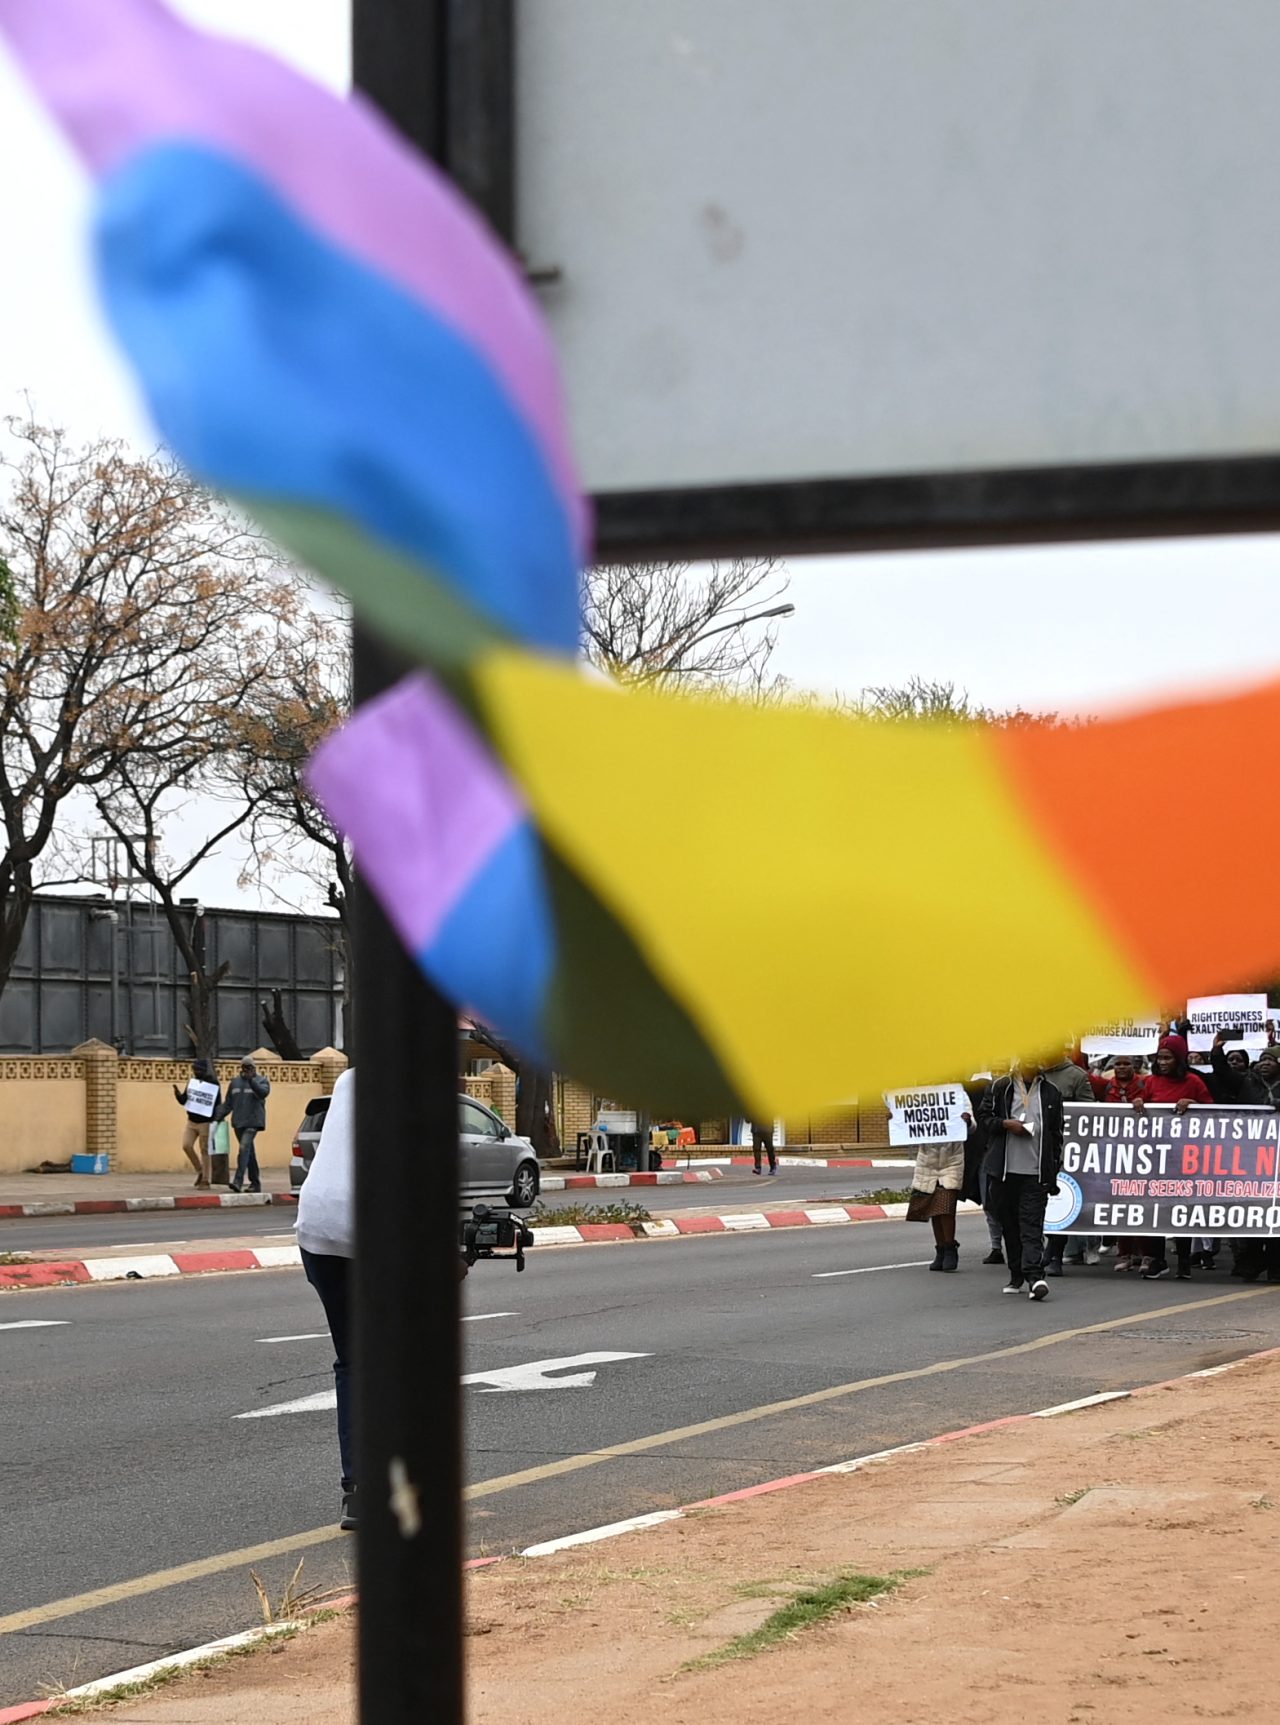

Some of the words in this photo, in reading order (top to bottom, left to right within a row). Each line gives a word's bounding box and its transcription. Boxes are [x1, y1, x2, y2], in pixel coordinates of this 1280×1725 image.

[1191, 1010, 1263, 1023] RIGHTEOUSNESS
[1085, 1025, 1157, 1039] OMOSEXUALITY
[1190, 1022, 1222, 1034] EXALTS
[894, 1092, 940, 1109] MOSADI
[942, 1091, 956, 1106] LE
[904, 1107, 949, 1123] MOSADI
[908, 1122, 948, 1138] NNYAA
[1078, 1115, 1164, 1138] CHURCH
[1170, 1116, 1182, 1138] &
[1063, 1142, 1172, 1175] GAINST
[1181, 1144, 1247, 1176] BILL
[1110, 1178, 1149, 1196] THAT
[1148, 1179, 1194, 1197] SEEKS
[1195, 1180, 1215, 1197] TO
[1093, 1203, 1145, 1226] EFB
